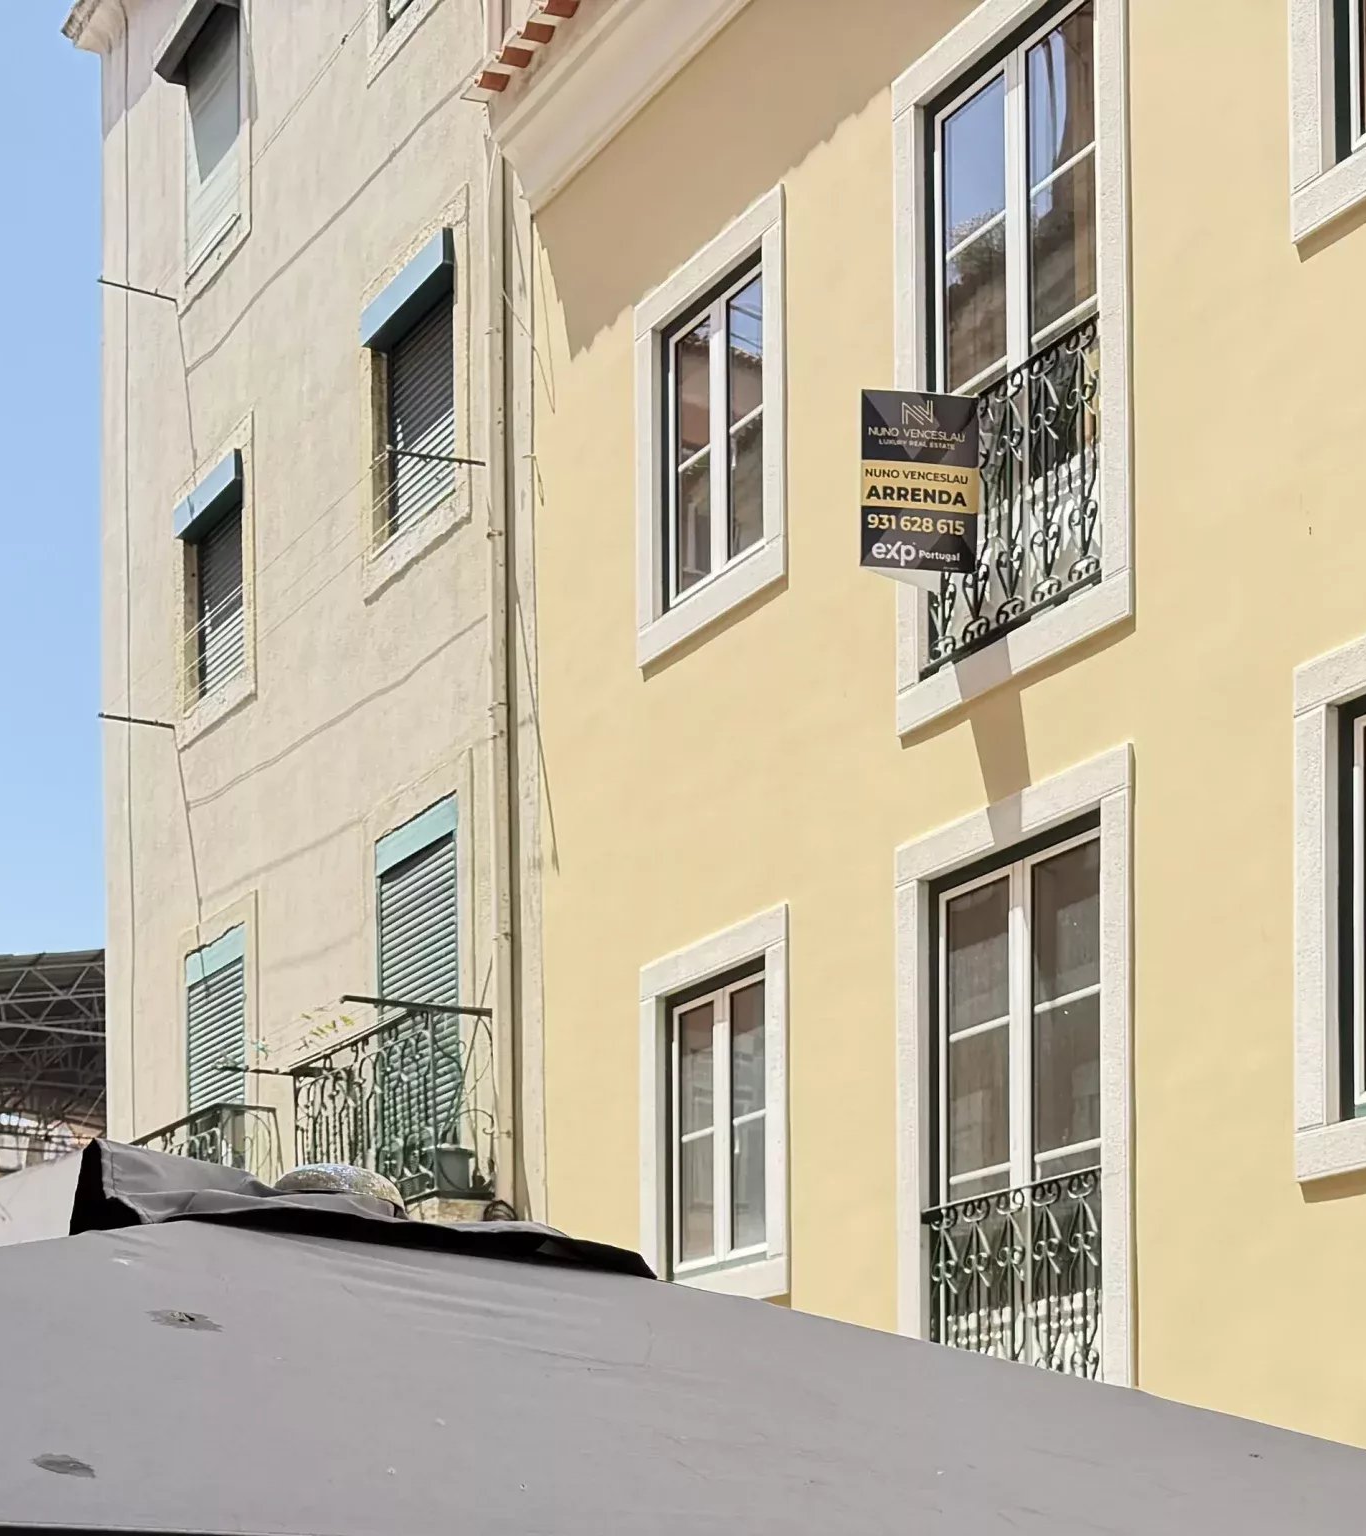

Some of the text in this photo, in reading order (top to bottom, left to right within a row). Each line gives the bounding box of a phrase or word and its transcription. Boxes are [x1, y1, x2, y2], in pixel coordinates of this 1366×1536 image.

[868, 427, 966, 442] NUNO VENCESLAU
[909, 440, 928, 448] REAL
[865, 468, 968, 484] NUNO VENCESLAU
[866, 485, 967, 507] ARRENDA
[867, 513, 965, 536] 931 628 615
[871, 541, 960, 567] exp Portugal
